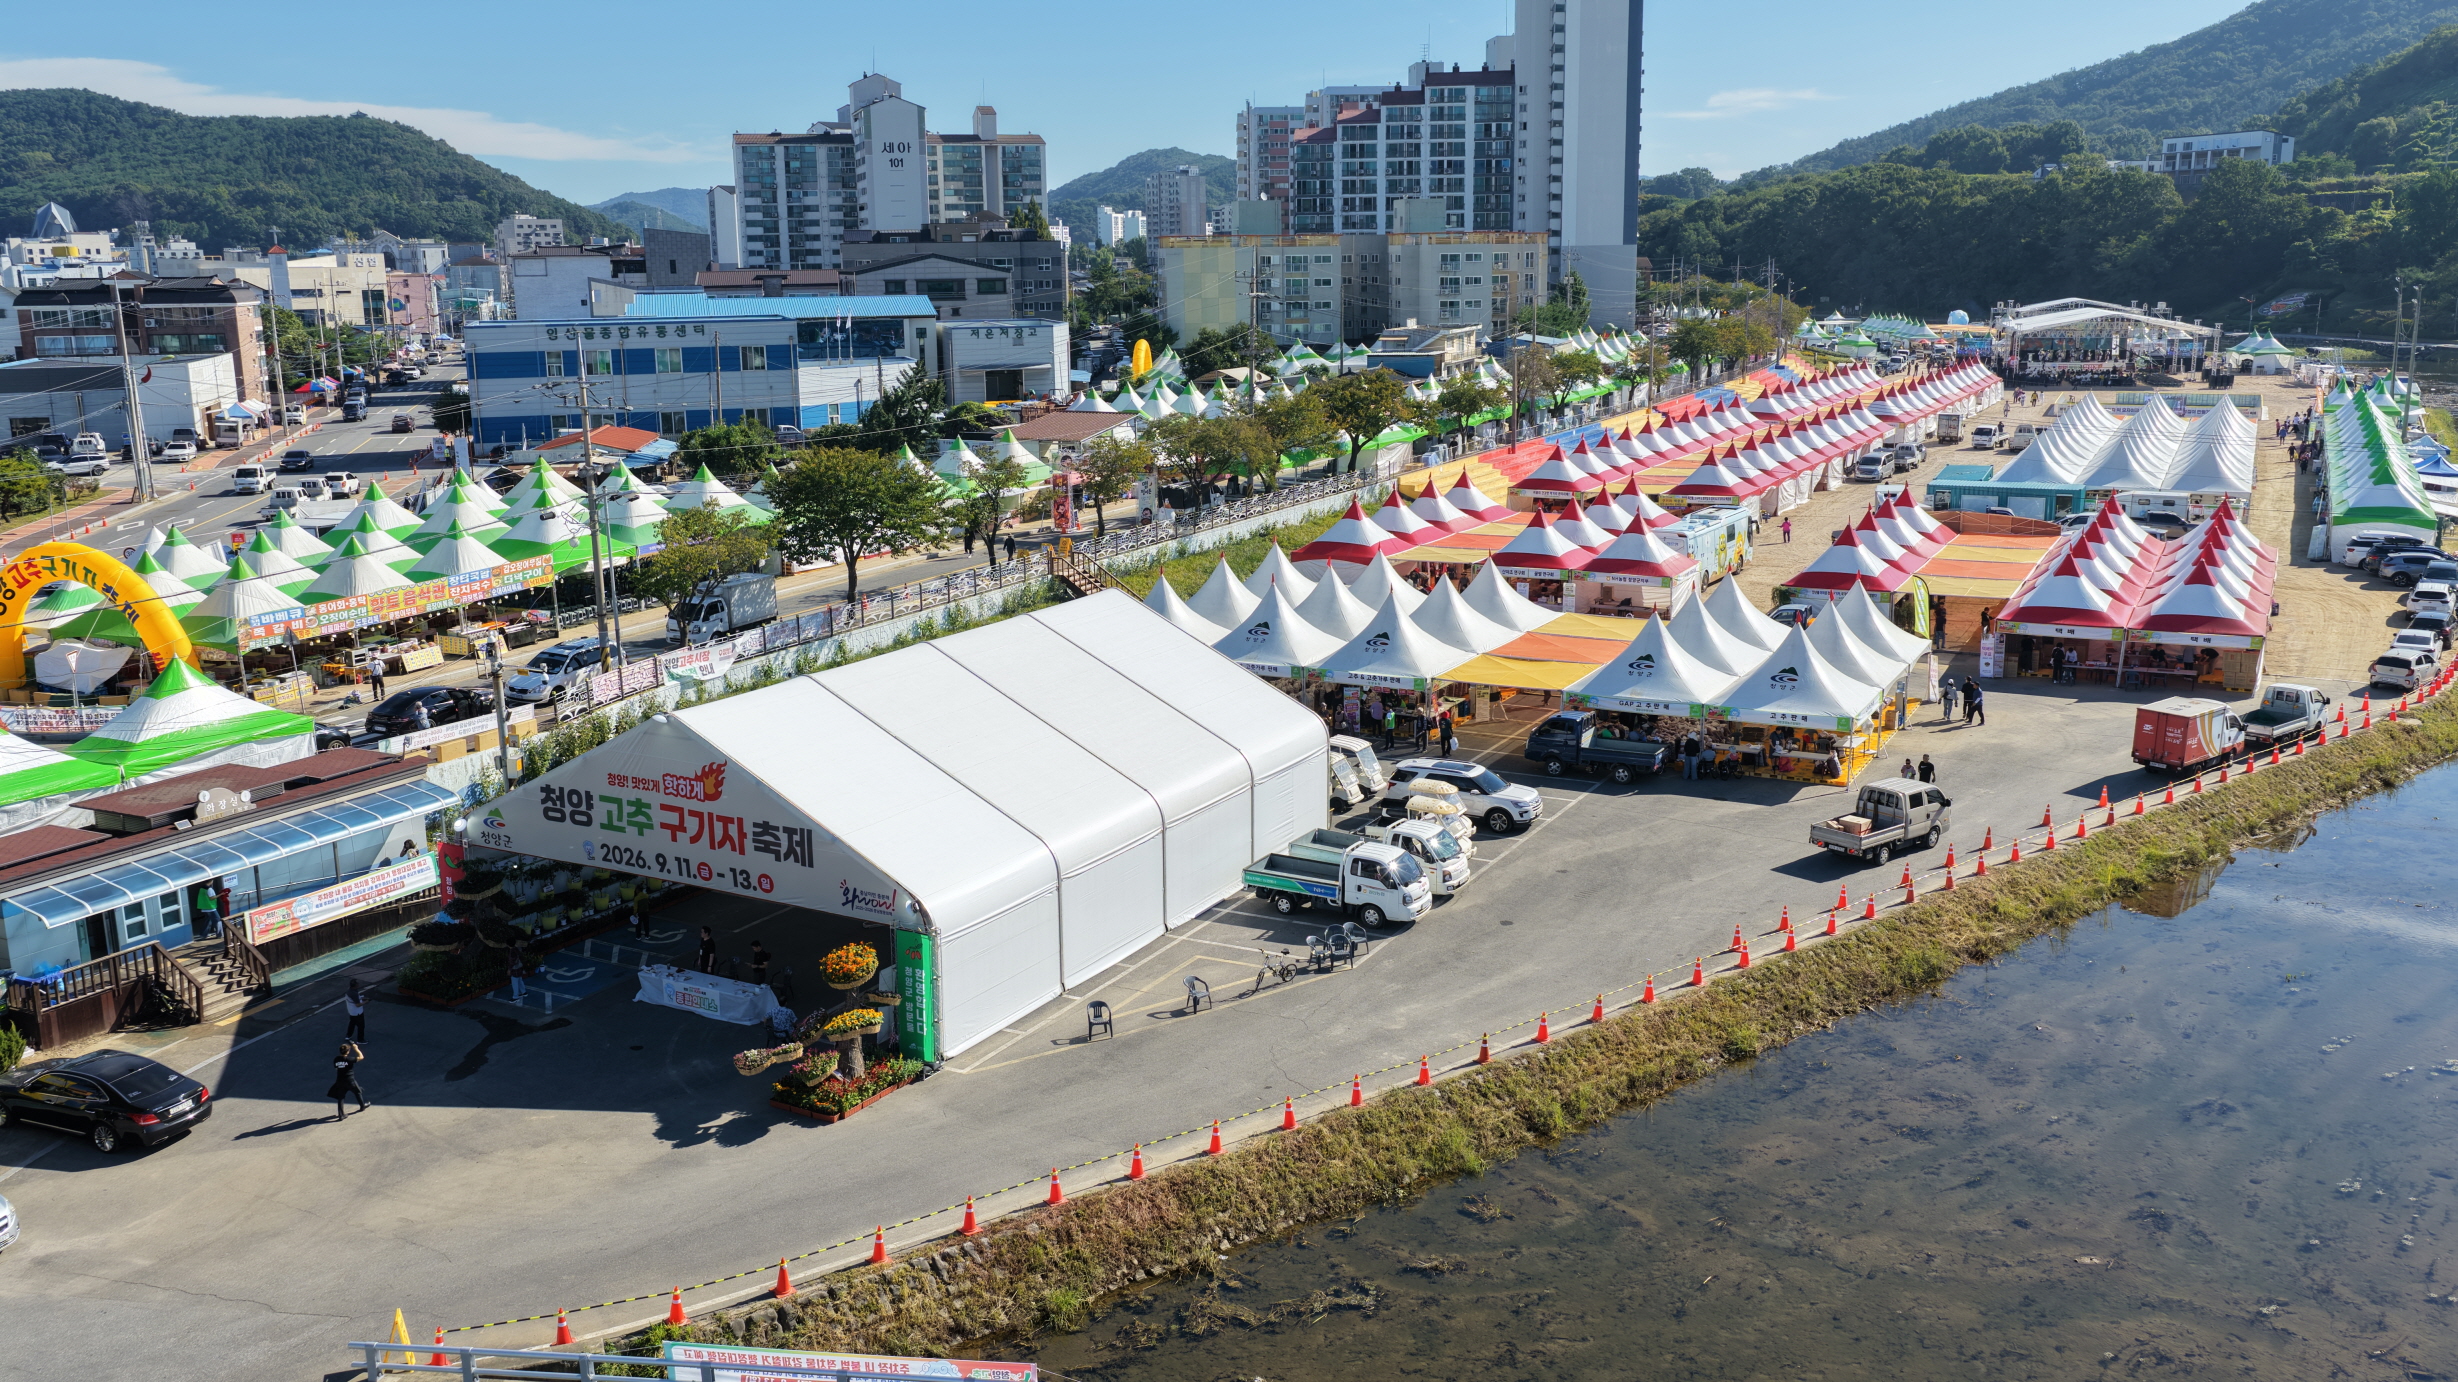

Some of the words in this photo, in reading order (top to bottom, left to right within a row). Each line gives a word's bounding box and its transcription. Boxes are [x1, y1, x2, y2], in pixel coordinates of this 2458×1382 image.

[881, 142, 912, 153] 세아
[889, 158, 904, 167] 101
[970, 327, 1038, 339] 저온저장고
[261, 608, 302, 623] 바베큐
[2190, 636, 2211, 644] 택배
[607, 772, 629, 788] 청양!
[631, 776, 660, 793] 맛있게
[663, 775, 705, 800] 핫하게
[206, 796, 239, 812] 화장실
[201, 812, 224, 822] TOILET
[539, 784, 594, 827] 청양
[599, 793, 655, 837] 고추
[659, 802, 747, 856] 구기자
[752, 820, 815, 869] 축제
[480, 831, 513, 848] 청양군
[601, 843, 652, 870] 2026.
[655, 852, 672, 875] 9.
[905, 966, 913, 997] 청양군
[676, 991, 718, 1012] 종합안내소
[915, 968, 927, 1036] 환영합니다
